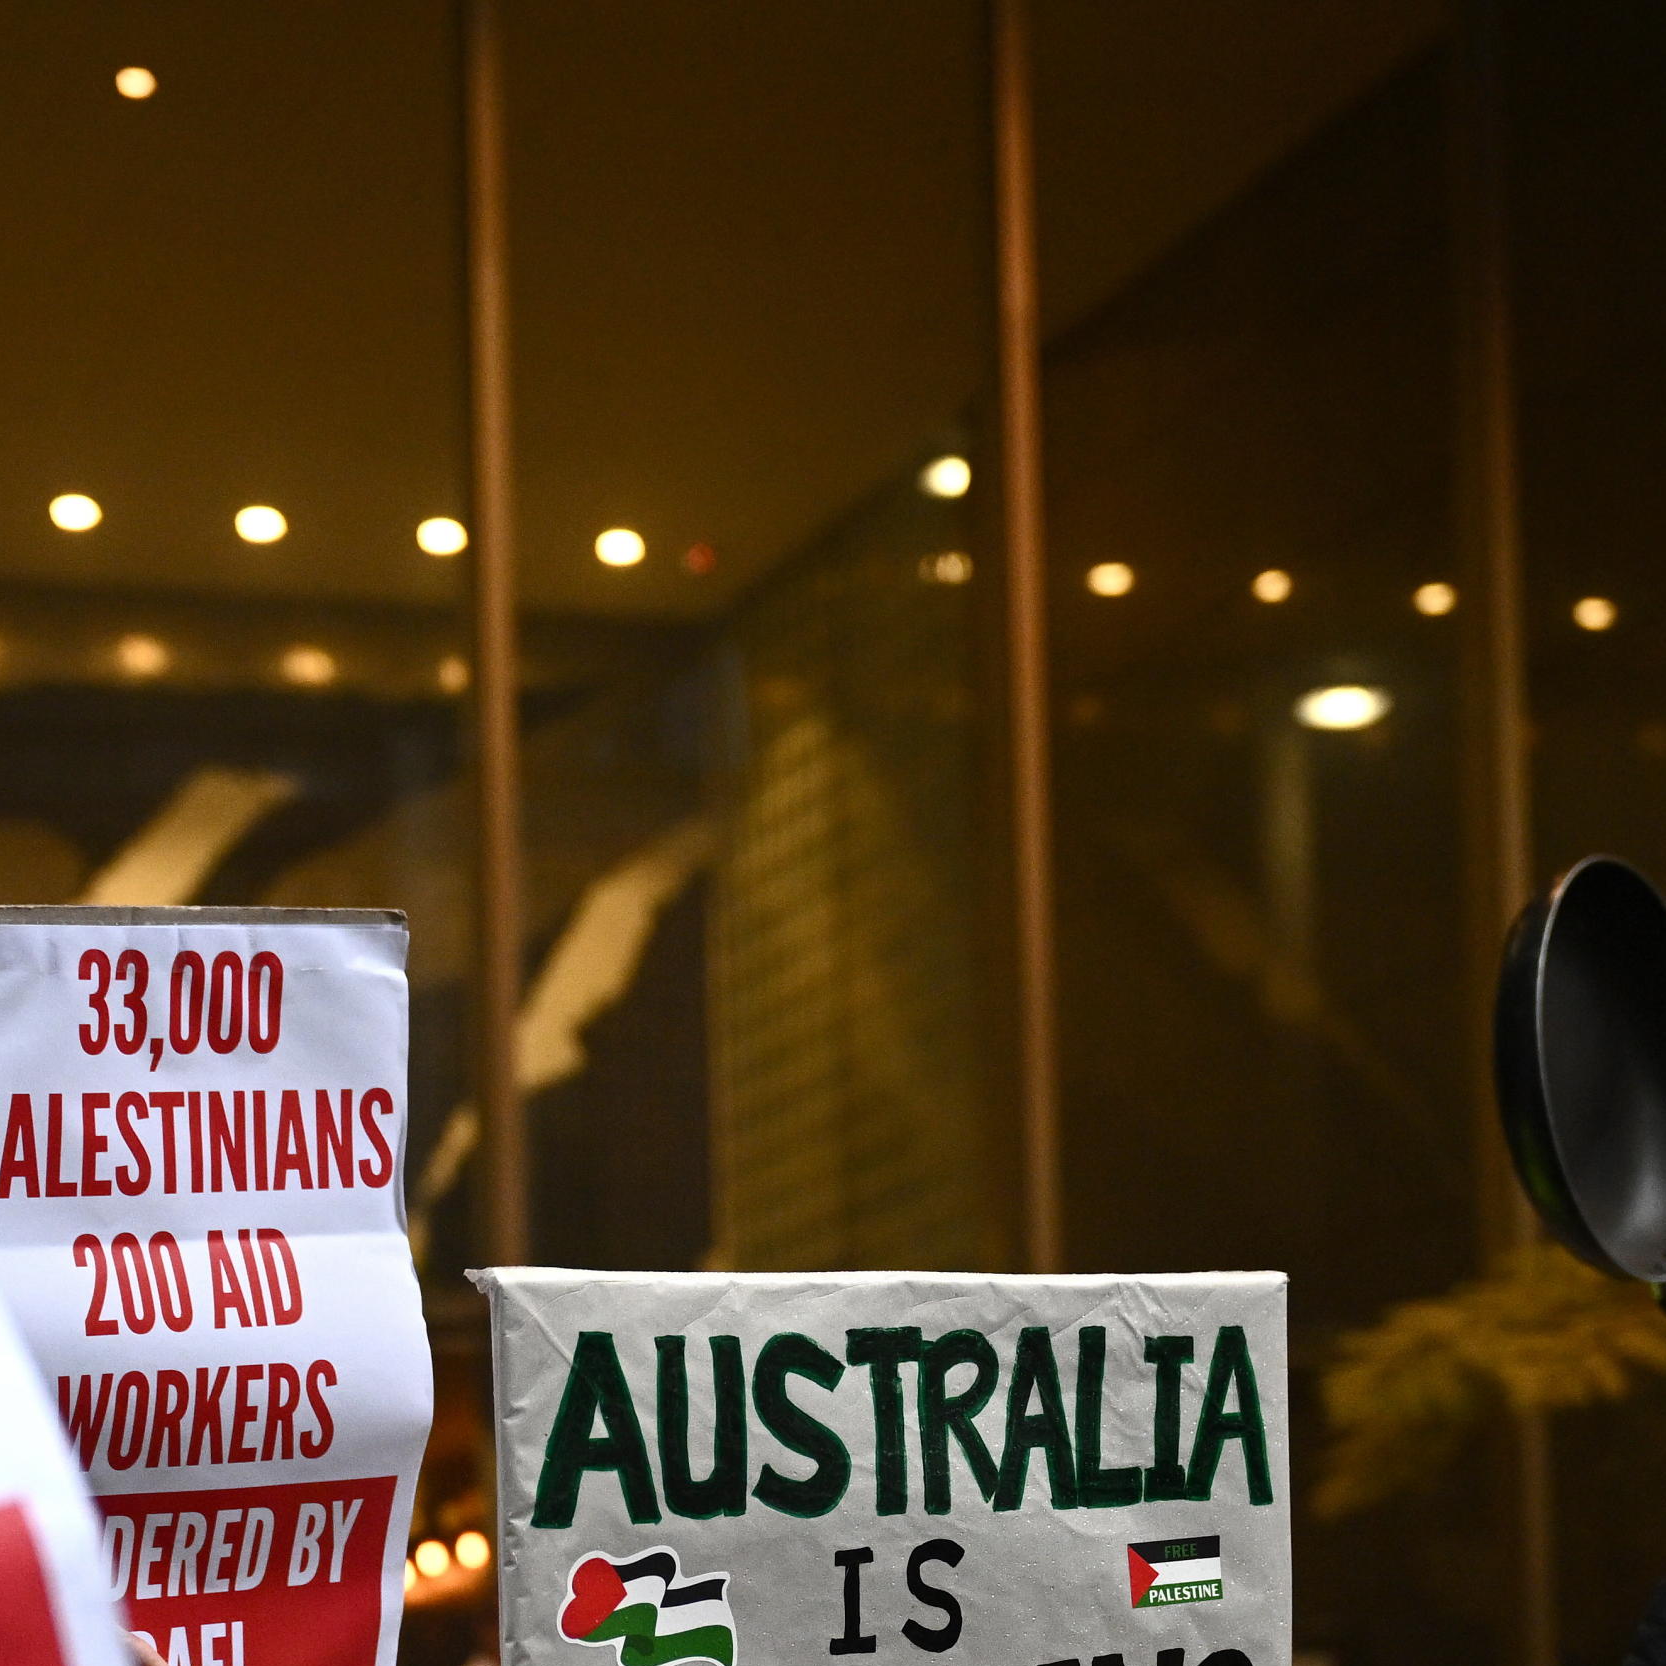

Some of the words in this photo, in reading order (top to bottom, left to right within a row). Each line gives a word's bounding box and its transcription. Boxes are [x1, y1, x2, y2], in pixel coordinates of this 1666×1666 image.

[78, 948, 284, 1072] 33,000
[72, 1231, 194, 1337] 200
[207, 1228, 304, 1329] AID
[57, 1359, 338, 1471] WORKERS
[530, 1325, 1274, 1530] AUSTRALIA
[286, 1498, 365, 1588] BY
[829, 1538, 966, 1656] IS
[1148, 1583, 1221, 1604] PALESTINE
[1164, 1543, 1198, 1560] FREE
